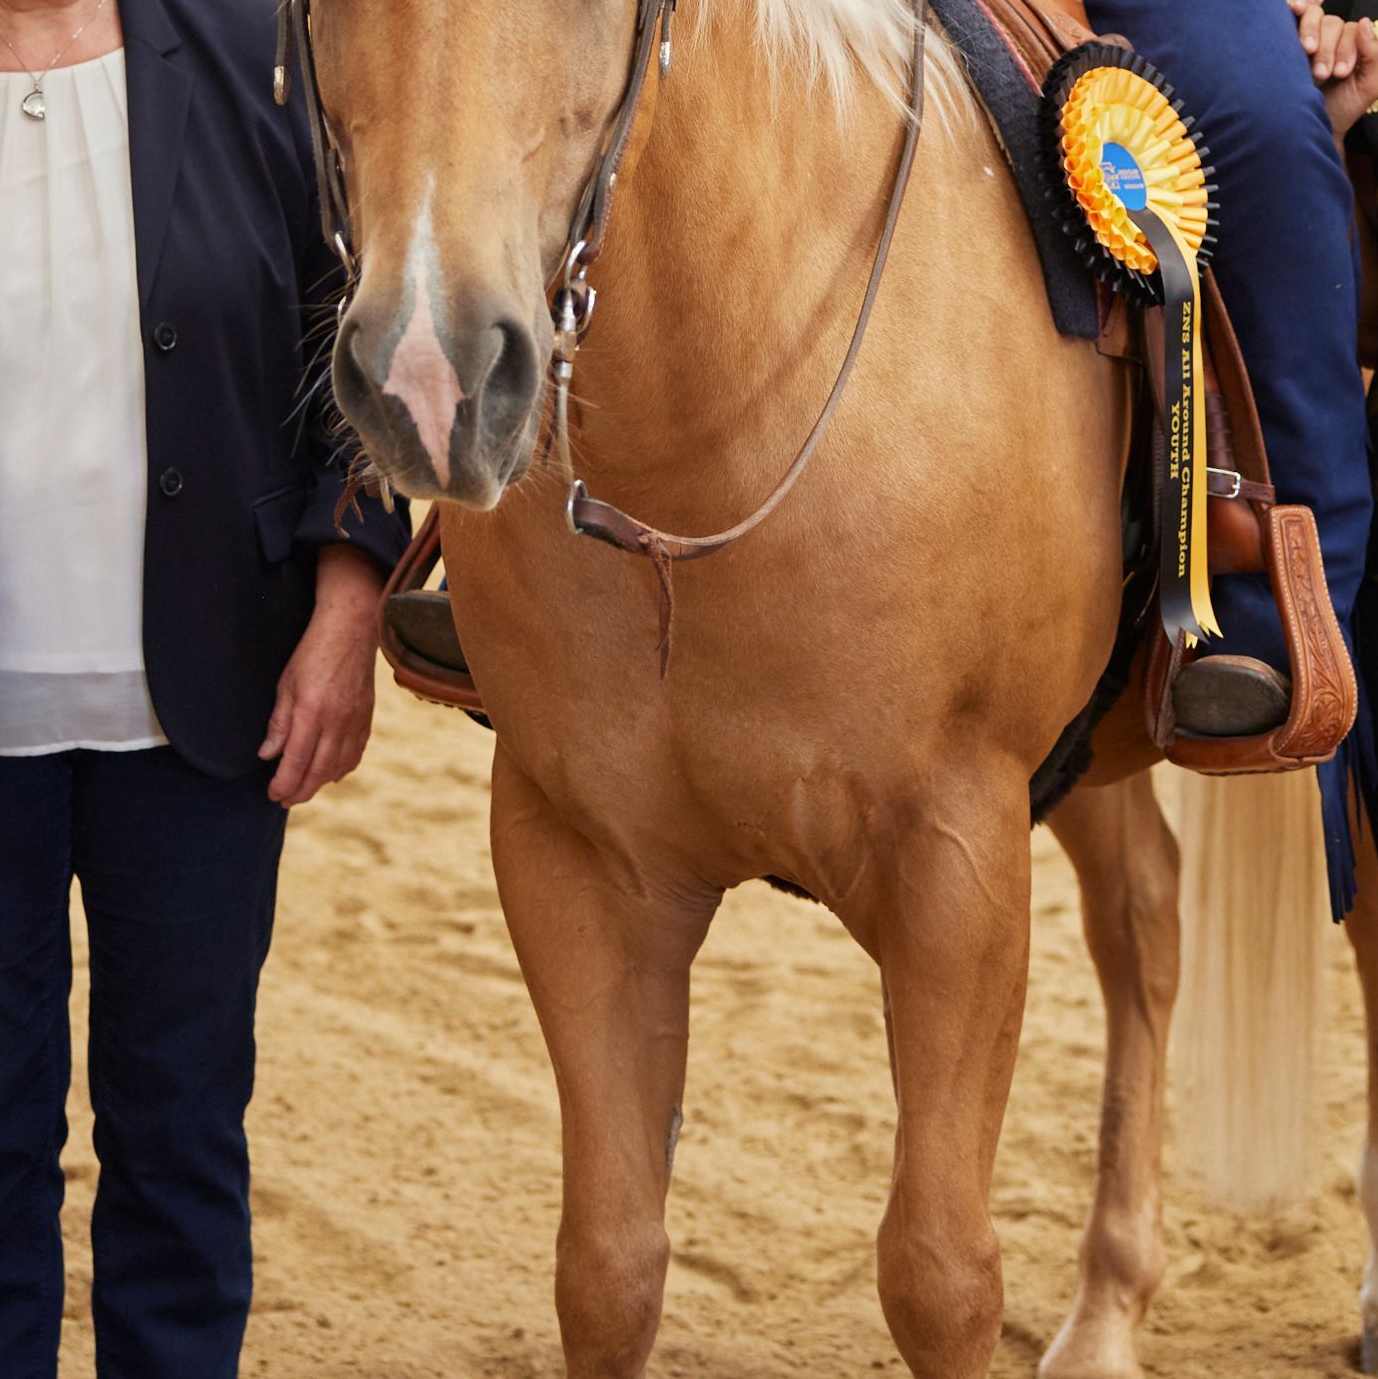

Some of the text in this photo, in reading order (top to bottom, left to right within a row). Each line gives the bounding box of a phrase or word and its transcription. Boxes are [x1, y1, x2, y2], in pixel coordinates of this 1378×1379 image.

[1169, 400, 1181, 480] YOUTH
[1177, 301, 1192, 578] ZNS All Around Champion
